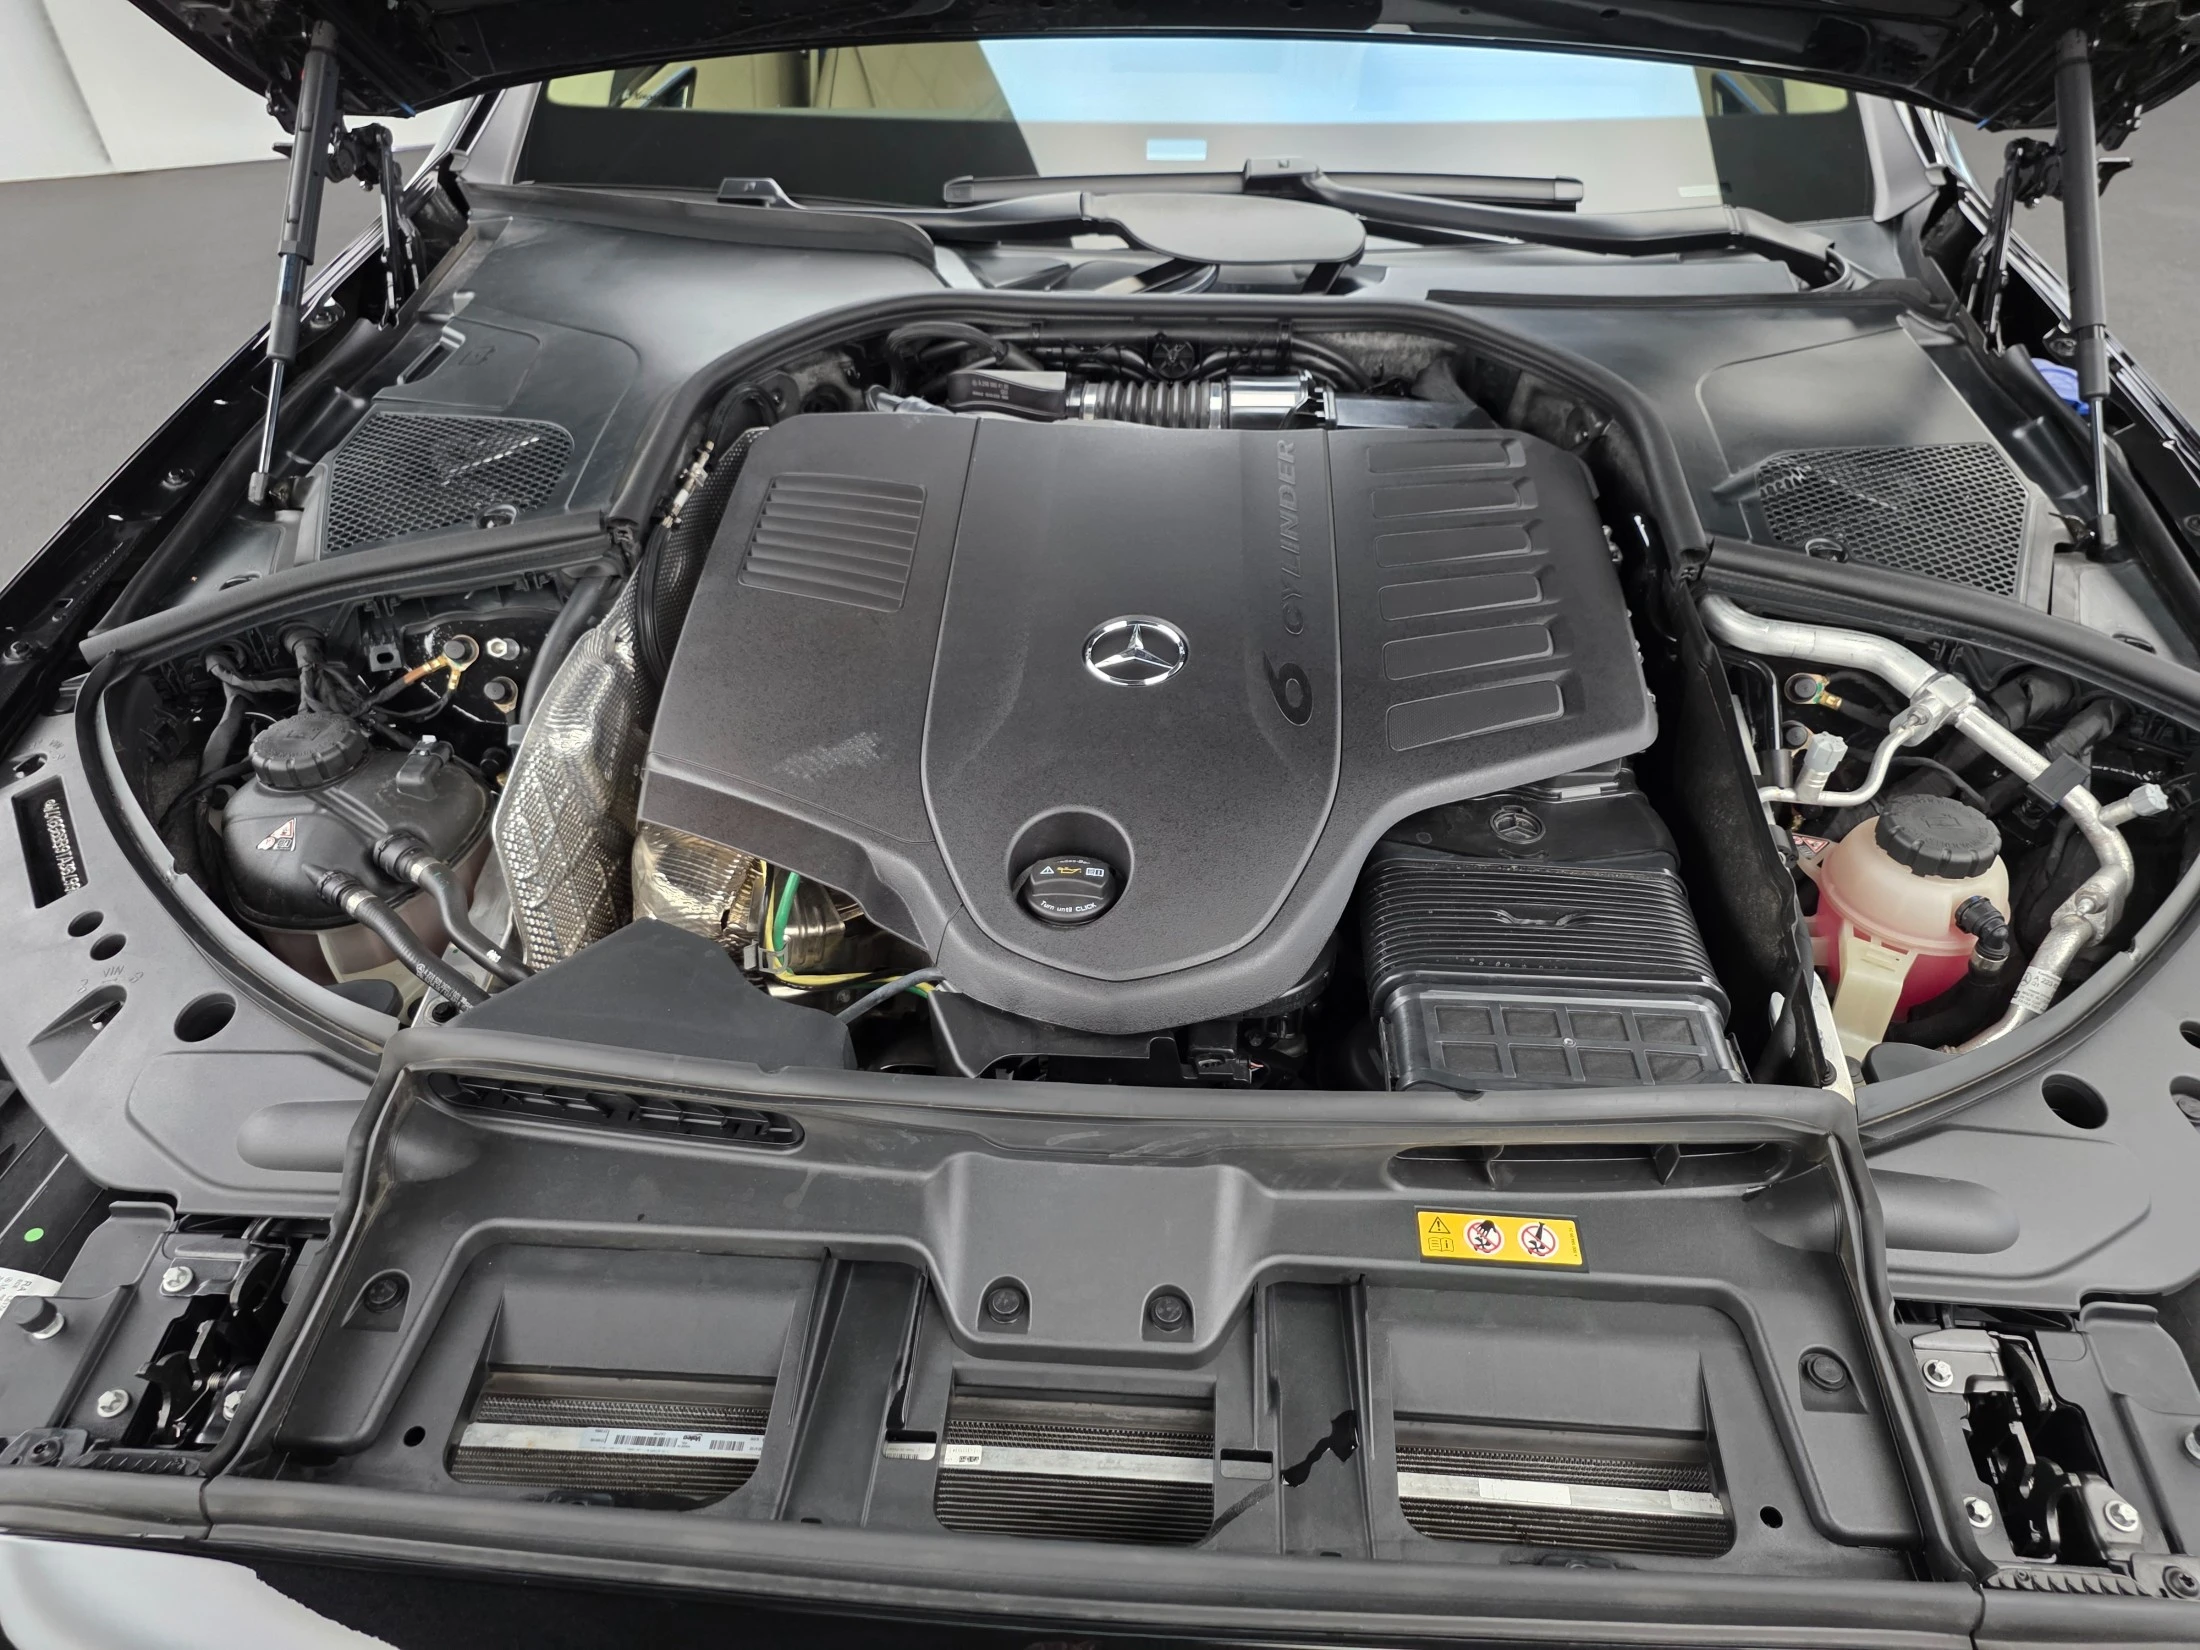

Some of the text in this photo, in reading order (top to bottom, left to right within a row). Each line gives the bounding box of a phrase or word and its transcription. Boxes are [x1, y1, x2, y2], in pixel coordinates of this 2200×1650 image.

[1263, 439, 1313, 726] 6 CYLINDER
[1041, 900, 1055, 911] Turn
[1075, 902, 1097, 912] CLICK
[103, 965, 125, 978] VIN
[683, 1434, 701, 1442] Valeo
